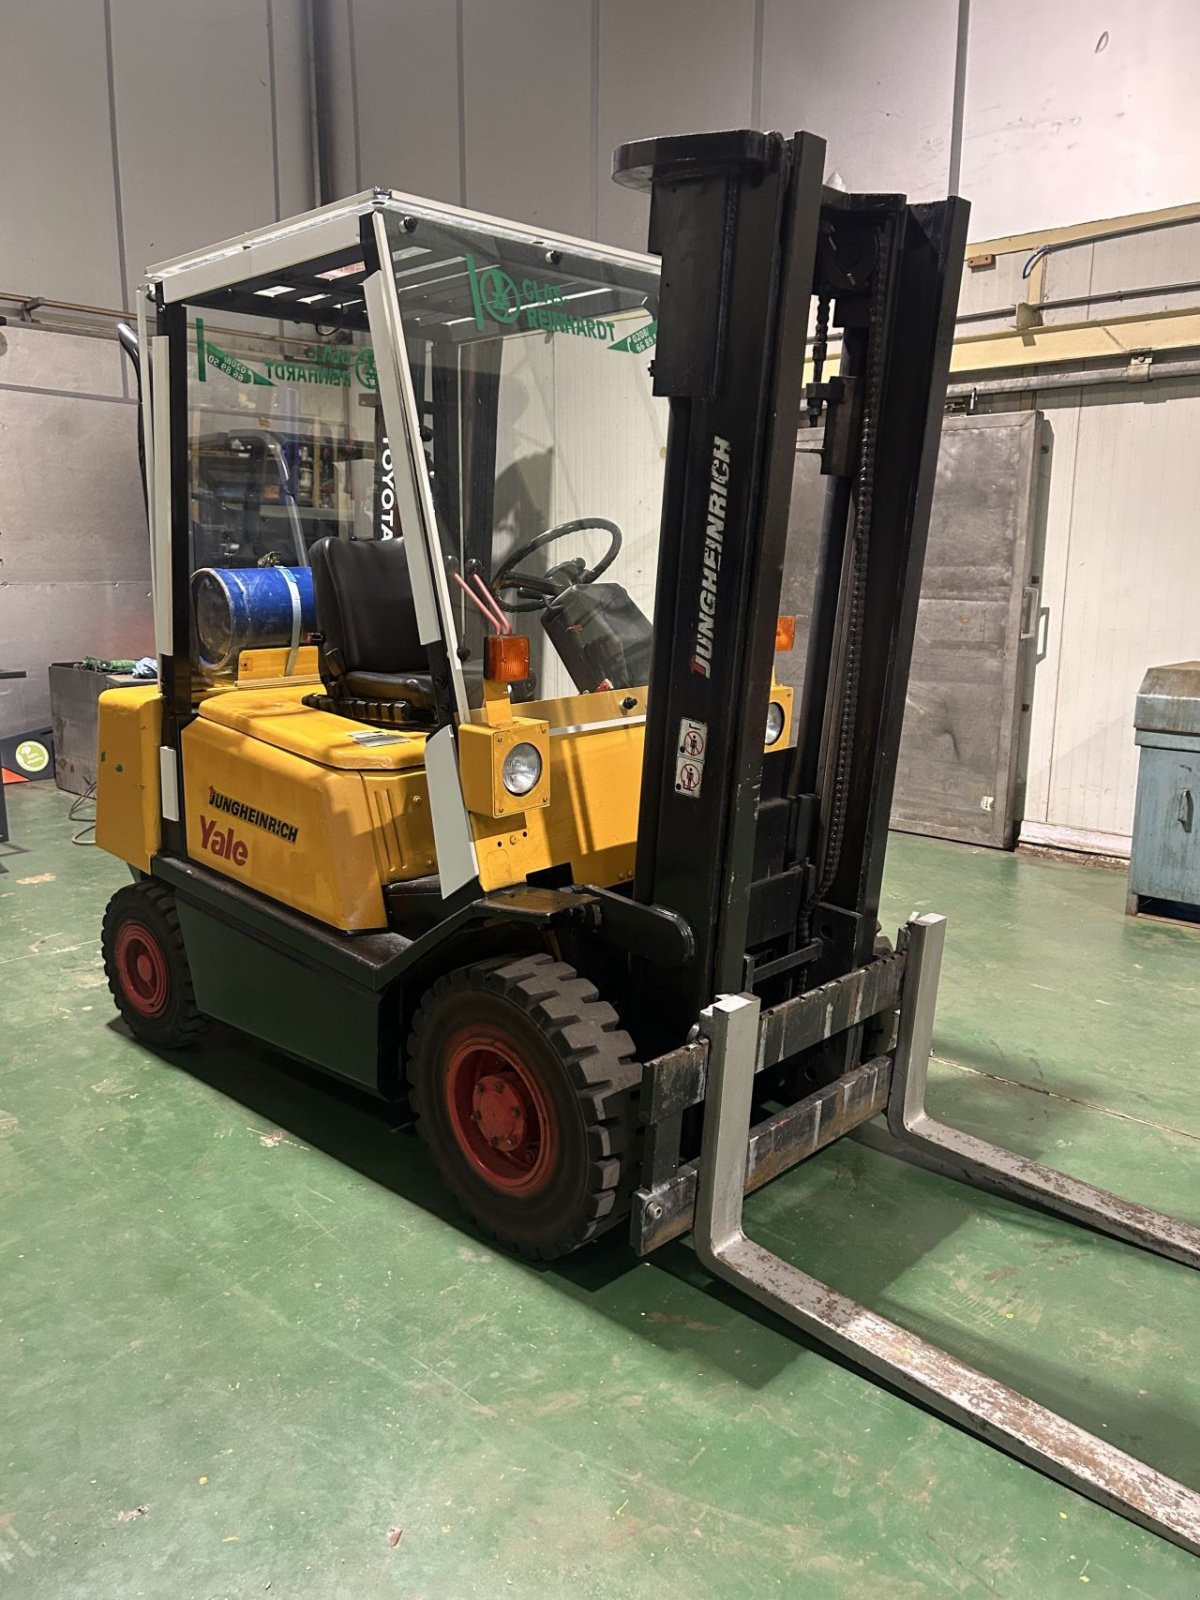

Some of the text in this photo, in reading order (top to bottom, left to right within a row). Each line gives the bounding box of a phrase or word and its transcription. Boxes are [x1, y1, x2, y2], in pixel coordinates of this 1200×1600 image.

[526, 307, 615, 341] REINHARDT
[690, 436, 731, 679] JUNGHEINRICH
[200, 815, 248, 866] Yale
[209, 786, 298, 843] JUNGHEINRICH
